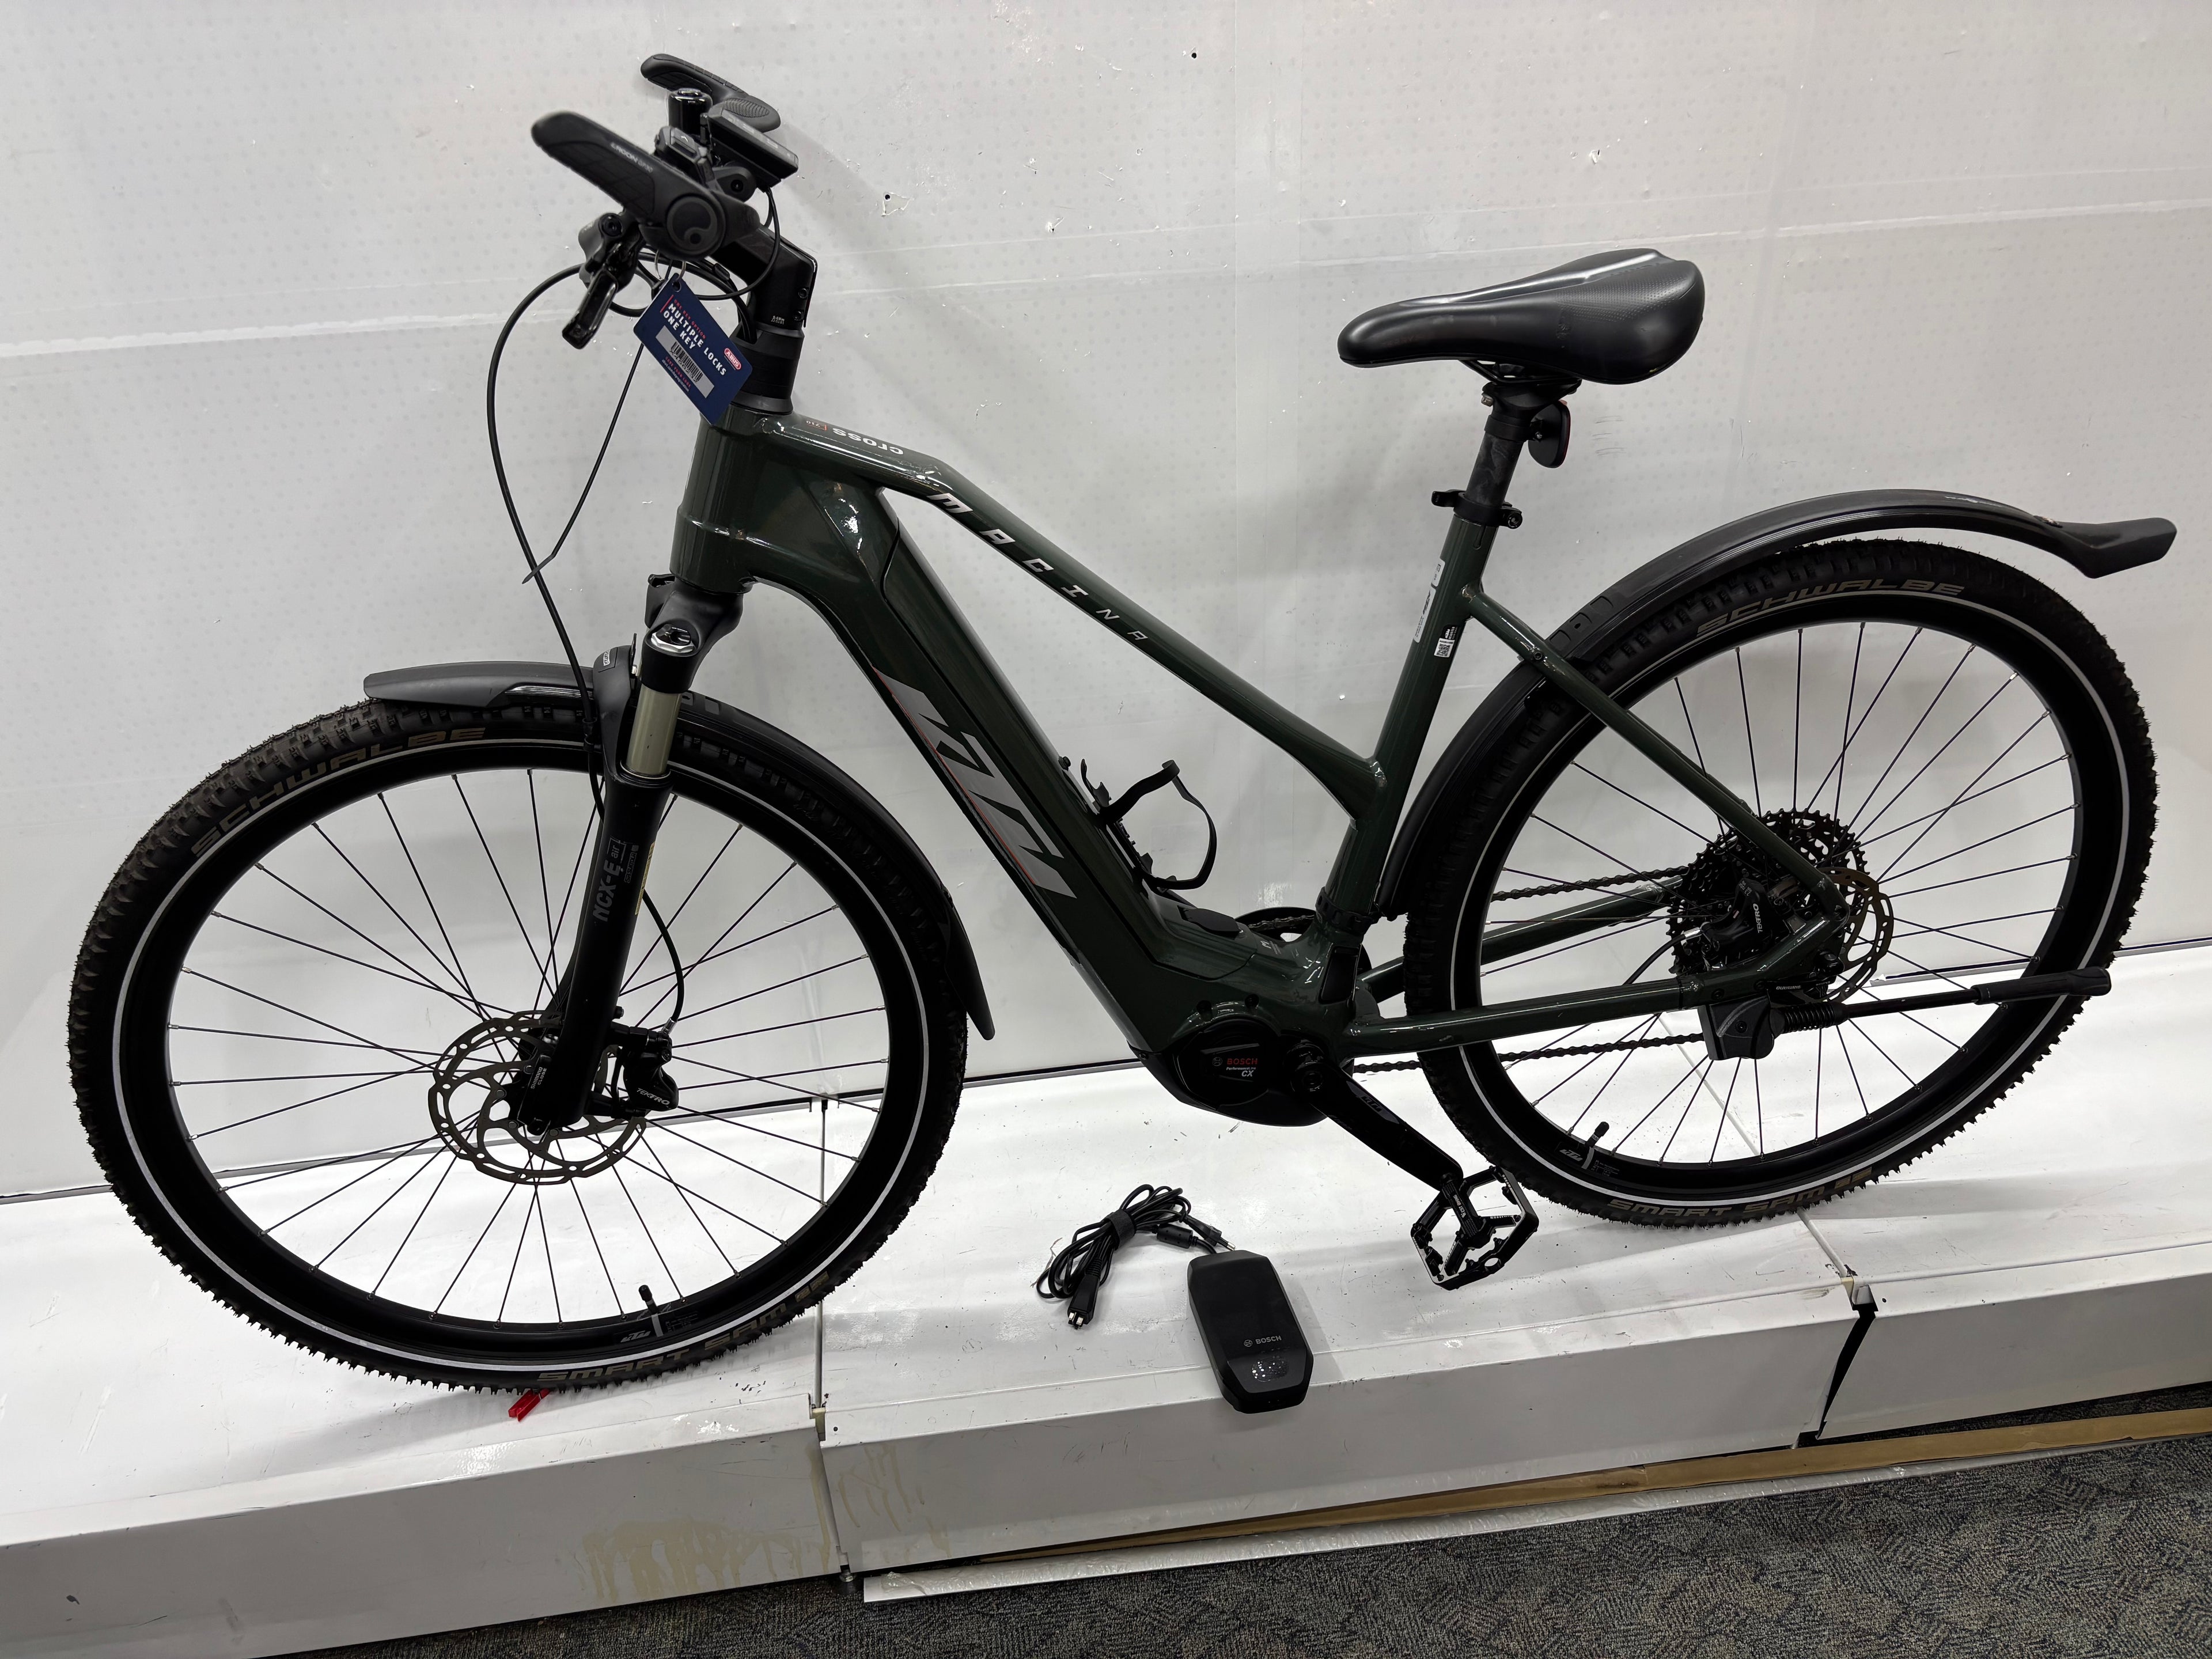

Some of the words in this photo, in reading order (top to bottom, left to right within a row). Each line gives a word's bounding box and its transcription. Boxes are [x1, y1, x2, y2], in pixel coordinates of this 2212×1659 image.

[663, 310, 678, 331] ONE
[679, 331, 696, 350] KEY
[668, 303, 704, 348] MULTIPLE
[703, 347, 727, 376] LOCKS
[726, 350, 740, 369] ABUS
[832, 426, 904, 456] cross
[926, 492, 1149, 641] MACINA
[1696, 578, 1965, 637] SCHWALBE
[191, 726, 487, 858] SCHWALBE
[872, 665, 1078, 899] KTM
[592, 859, 621, 922] NCX-E
[611, 844, 620, 859] air
[1752, 902, 1764, 934] TEKTRO
[531, 1066, 543, 1089] SHIMANO
[1226, 1057, 1259, 1067] BOSCH
[1241, 1070, 1254, 1078] CX
[637, 1088, 671, 1105] TEKTRO
[1559, 1149, 1584, 1161] KTM
[1607, 1198, 1733, 1217] SMART
[1744, 1186, 1825, 1214] SAM
[536, 1348, 690, 1381] SMART
[704, 1303, 787, 1351] SAM
[620, 1330, 651, 1343] KTM
[1255, 1335, 1282, 1345] BOSCH
